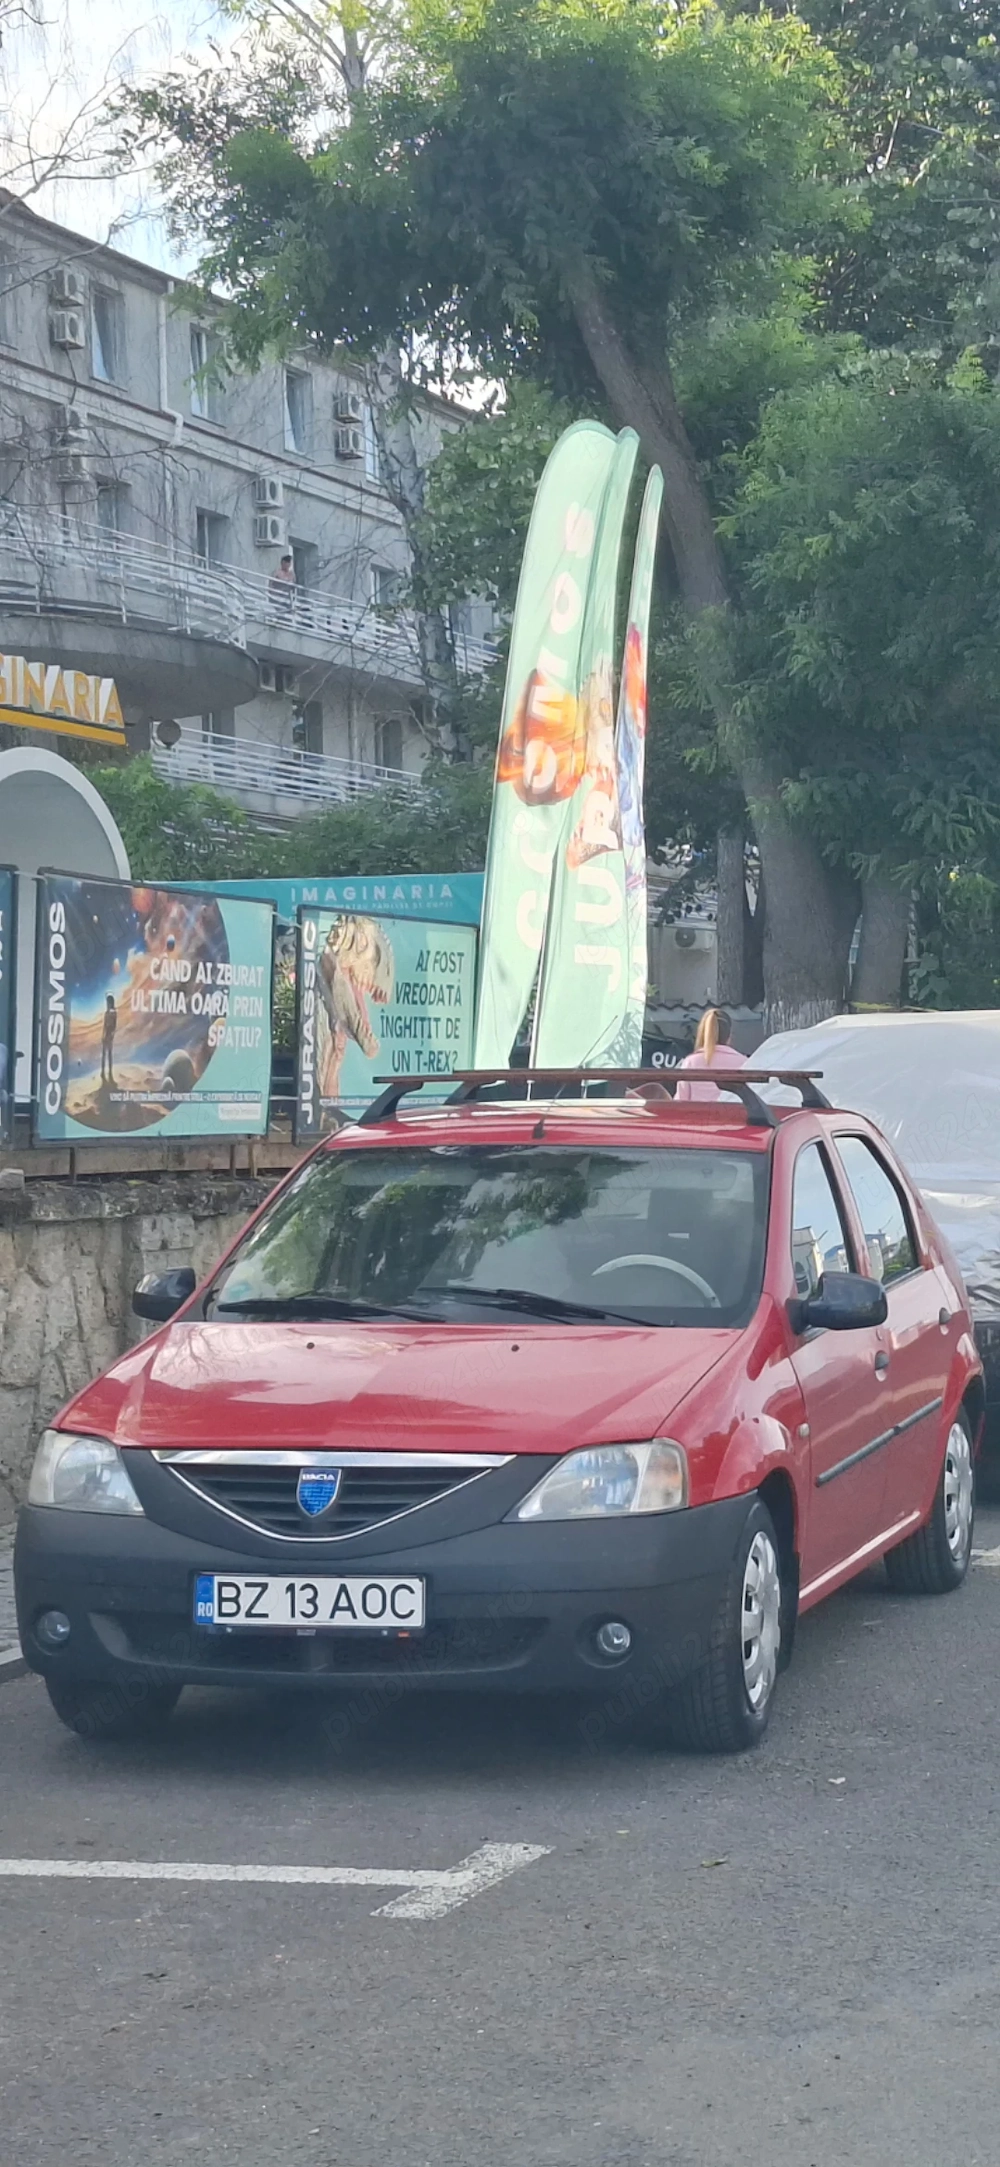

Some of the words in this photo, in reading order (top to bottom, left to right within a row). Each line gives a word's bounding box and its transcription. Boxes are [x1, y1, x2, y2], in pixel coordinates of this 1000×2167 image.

[290, 884, 453, 902] IMAGINARIA
[150, 955, 191, 983] CÂND
[196, 962, 213, 984] AI
[216, 963, 264, 988] ZBURAT
[415, 950, 430, 972] AI
[432, 951, 465, 974] FOST
[131, 989, 187, 1014] ULTIMA
[191, 990, 229, 1016] OARĂ
[233, 996, 263, 1017] PRIN
[394, 979, 462, 1006] VREODATĂ
[45, 901, 66, 1115] COSMOS
[301, 920, 316, 1125] JURASSIC
[380, 1008, 441, 1046] ÎNGHIȚIT
[446, 1018, 461, 1040] DE
[207, 1026, 262, 1054] SPAȚIU?
[392, 1050, 410, 1072] UN
[415, 1051, 458, 1073] T-REX?
[302, 1473, 335, 1481] DACIA
[197, 1602, 213, 1617] RO
[217, 1582, 269, 1618] BZ
[285, 1583, 319, 1619] 13
[329, 1583, 415, 1620] AOC
